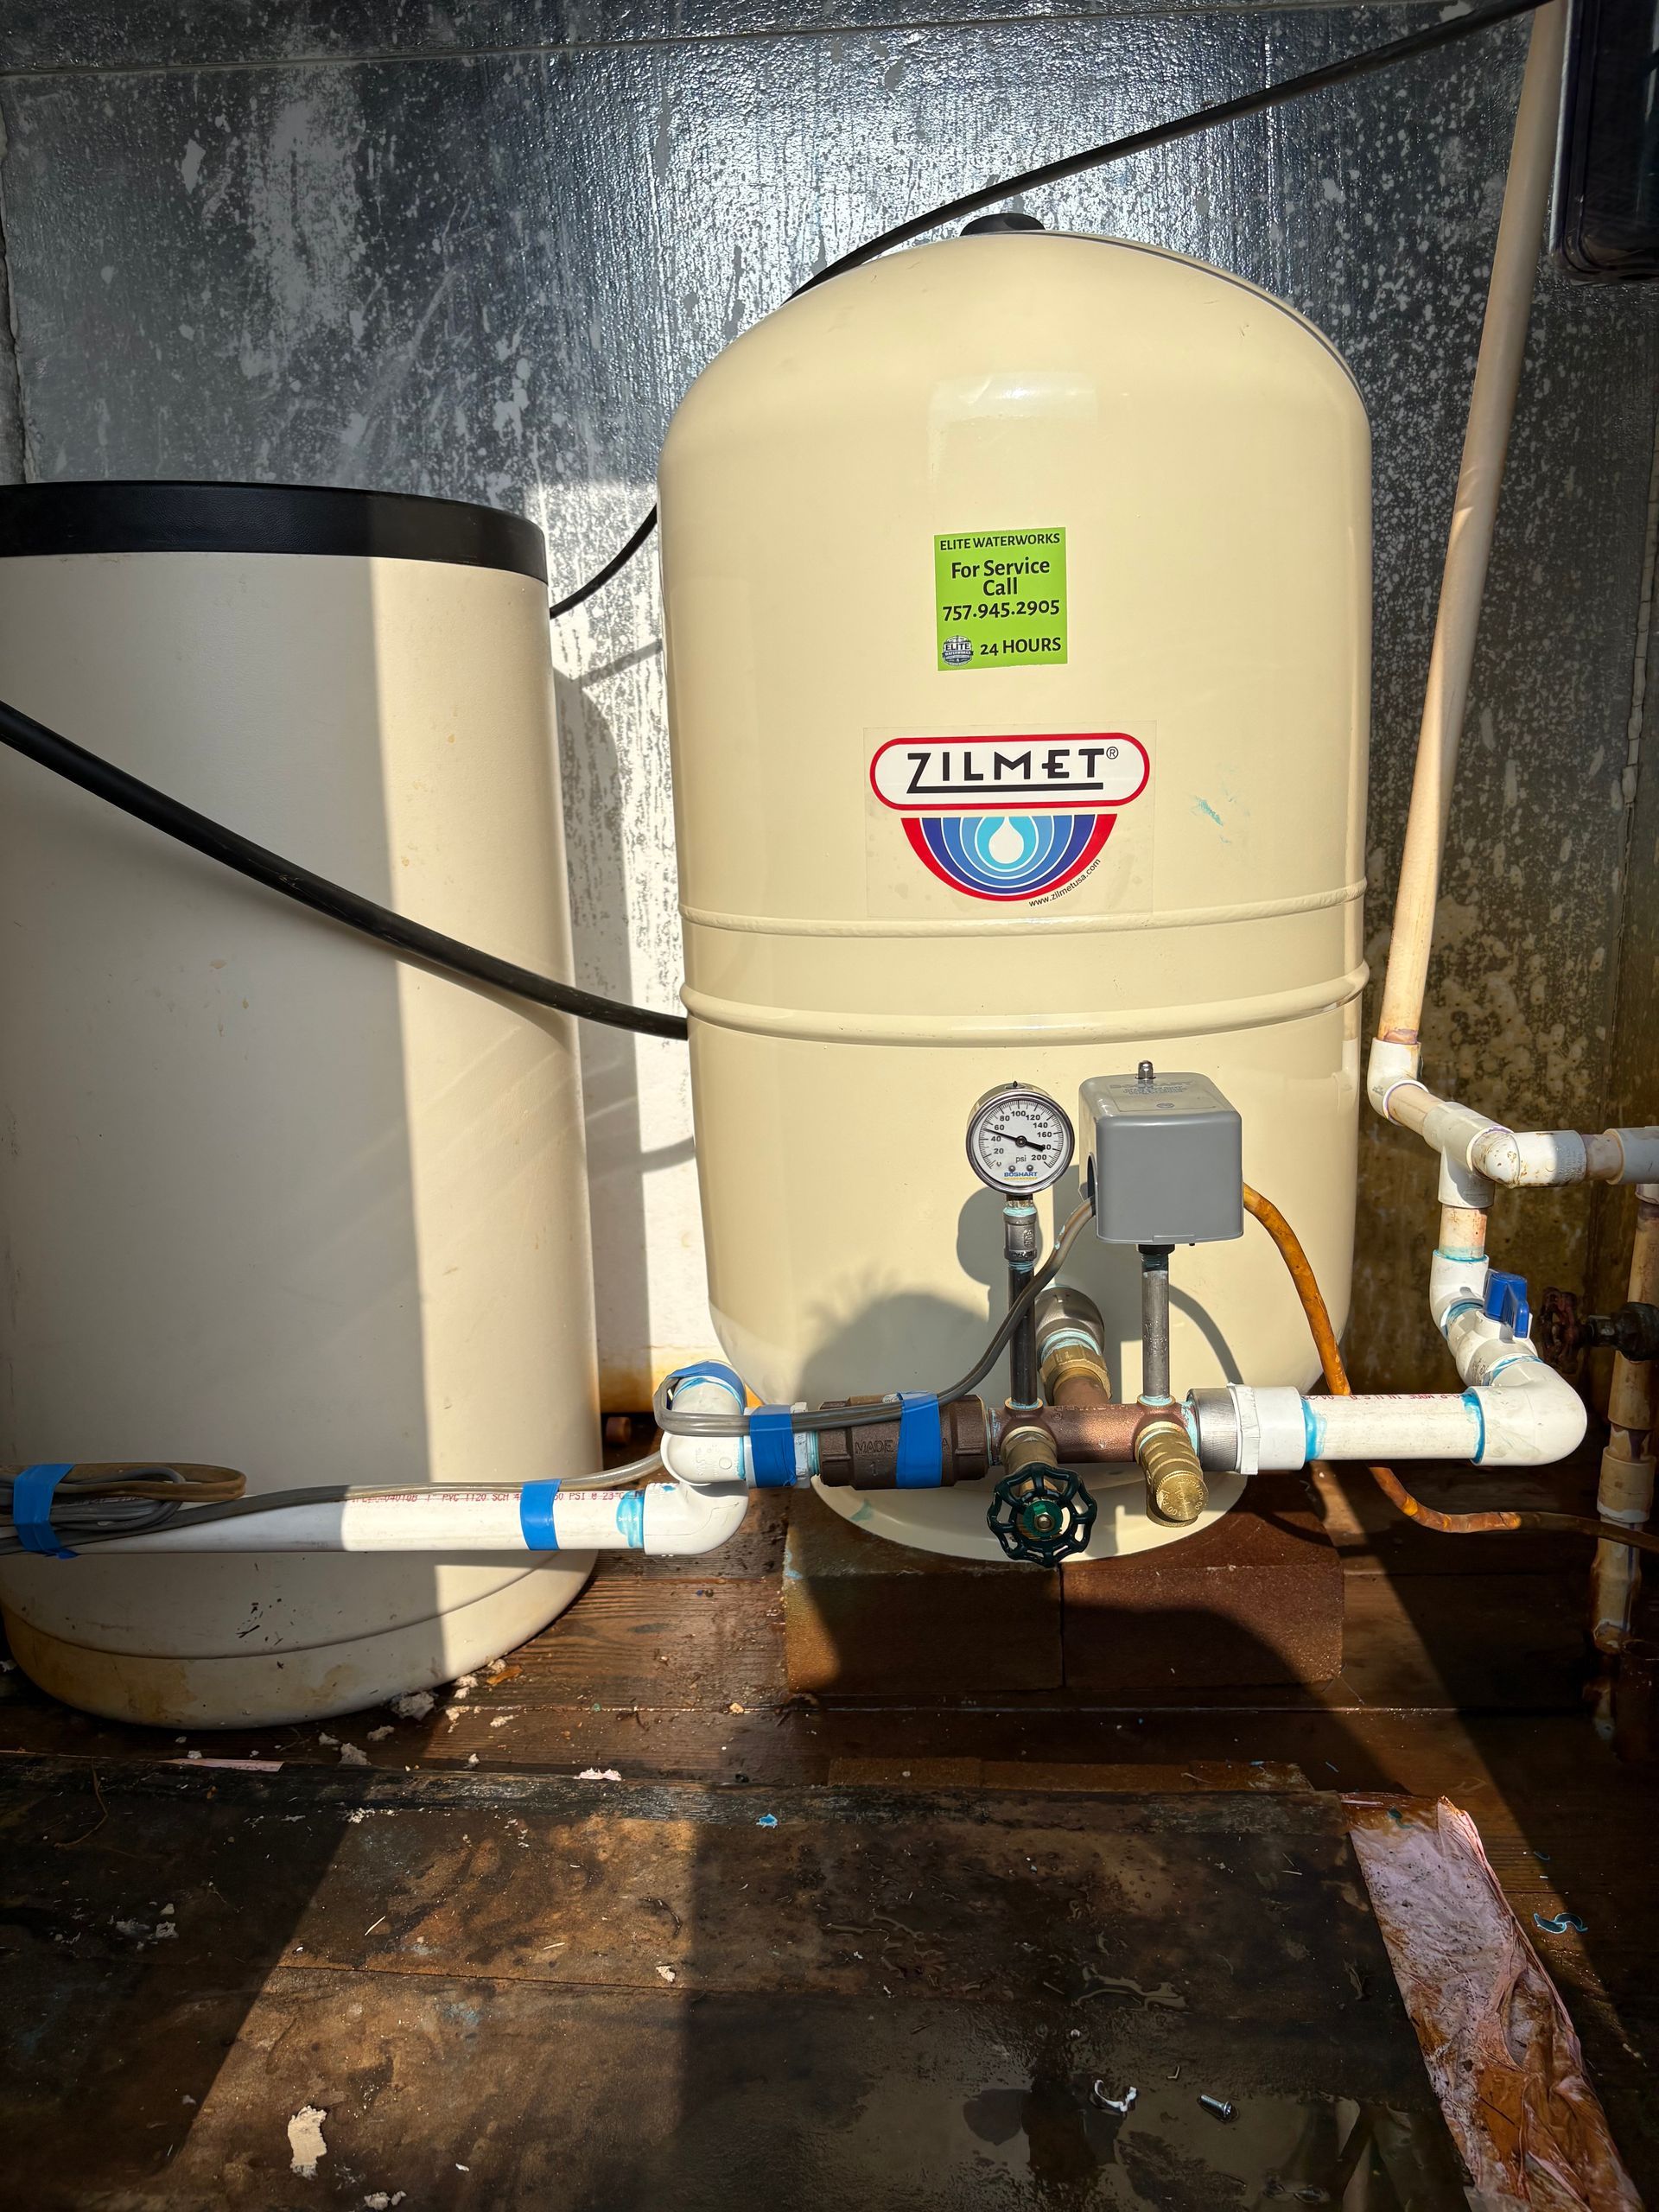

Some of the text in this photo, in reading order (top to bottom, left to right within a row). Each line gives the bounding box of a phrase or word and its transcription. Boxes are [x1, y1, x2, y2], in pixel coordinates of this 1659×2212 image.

[940, 532, 1060, 550] ELITE WATERWORKS
[951, 556, 1050, 579] For Service
[982, 577, 1018, 596] Call
[943, 600, 1060, 621] 757.945.2905
[980, 638, 1061, 656] 24 HOURS
[1028, 858, 1102, 908] www.zilmetusa.com
[855, 1440, 894, 1453] MADE
[442, 1493, 459, 1502] PVC
[465, 1493, 487, 1502] 1120
[492, 1492, 510, 1501] SCH
[513, 1492, 521, 1501] 4
[569, 1492, 585, 1501] PSI
[602, 1492, 626, 1501] 23°C
[1160, 1489, 1171, 1506] PSI
